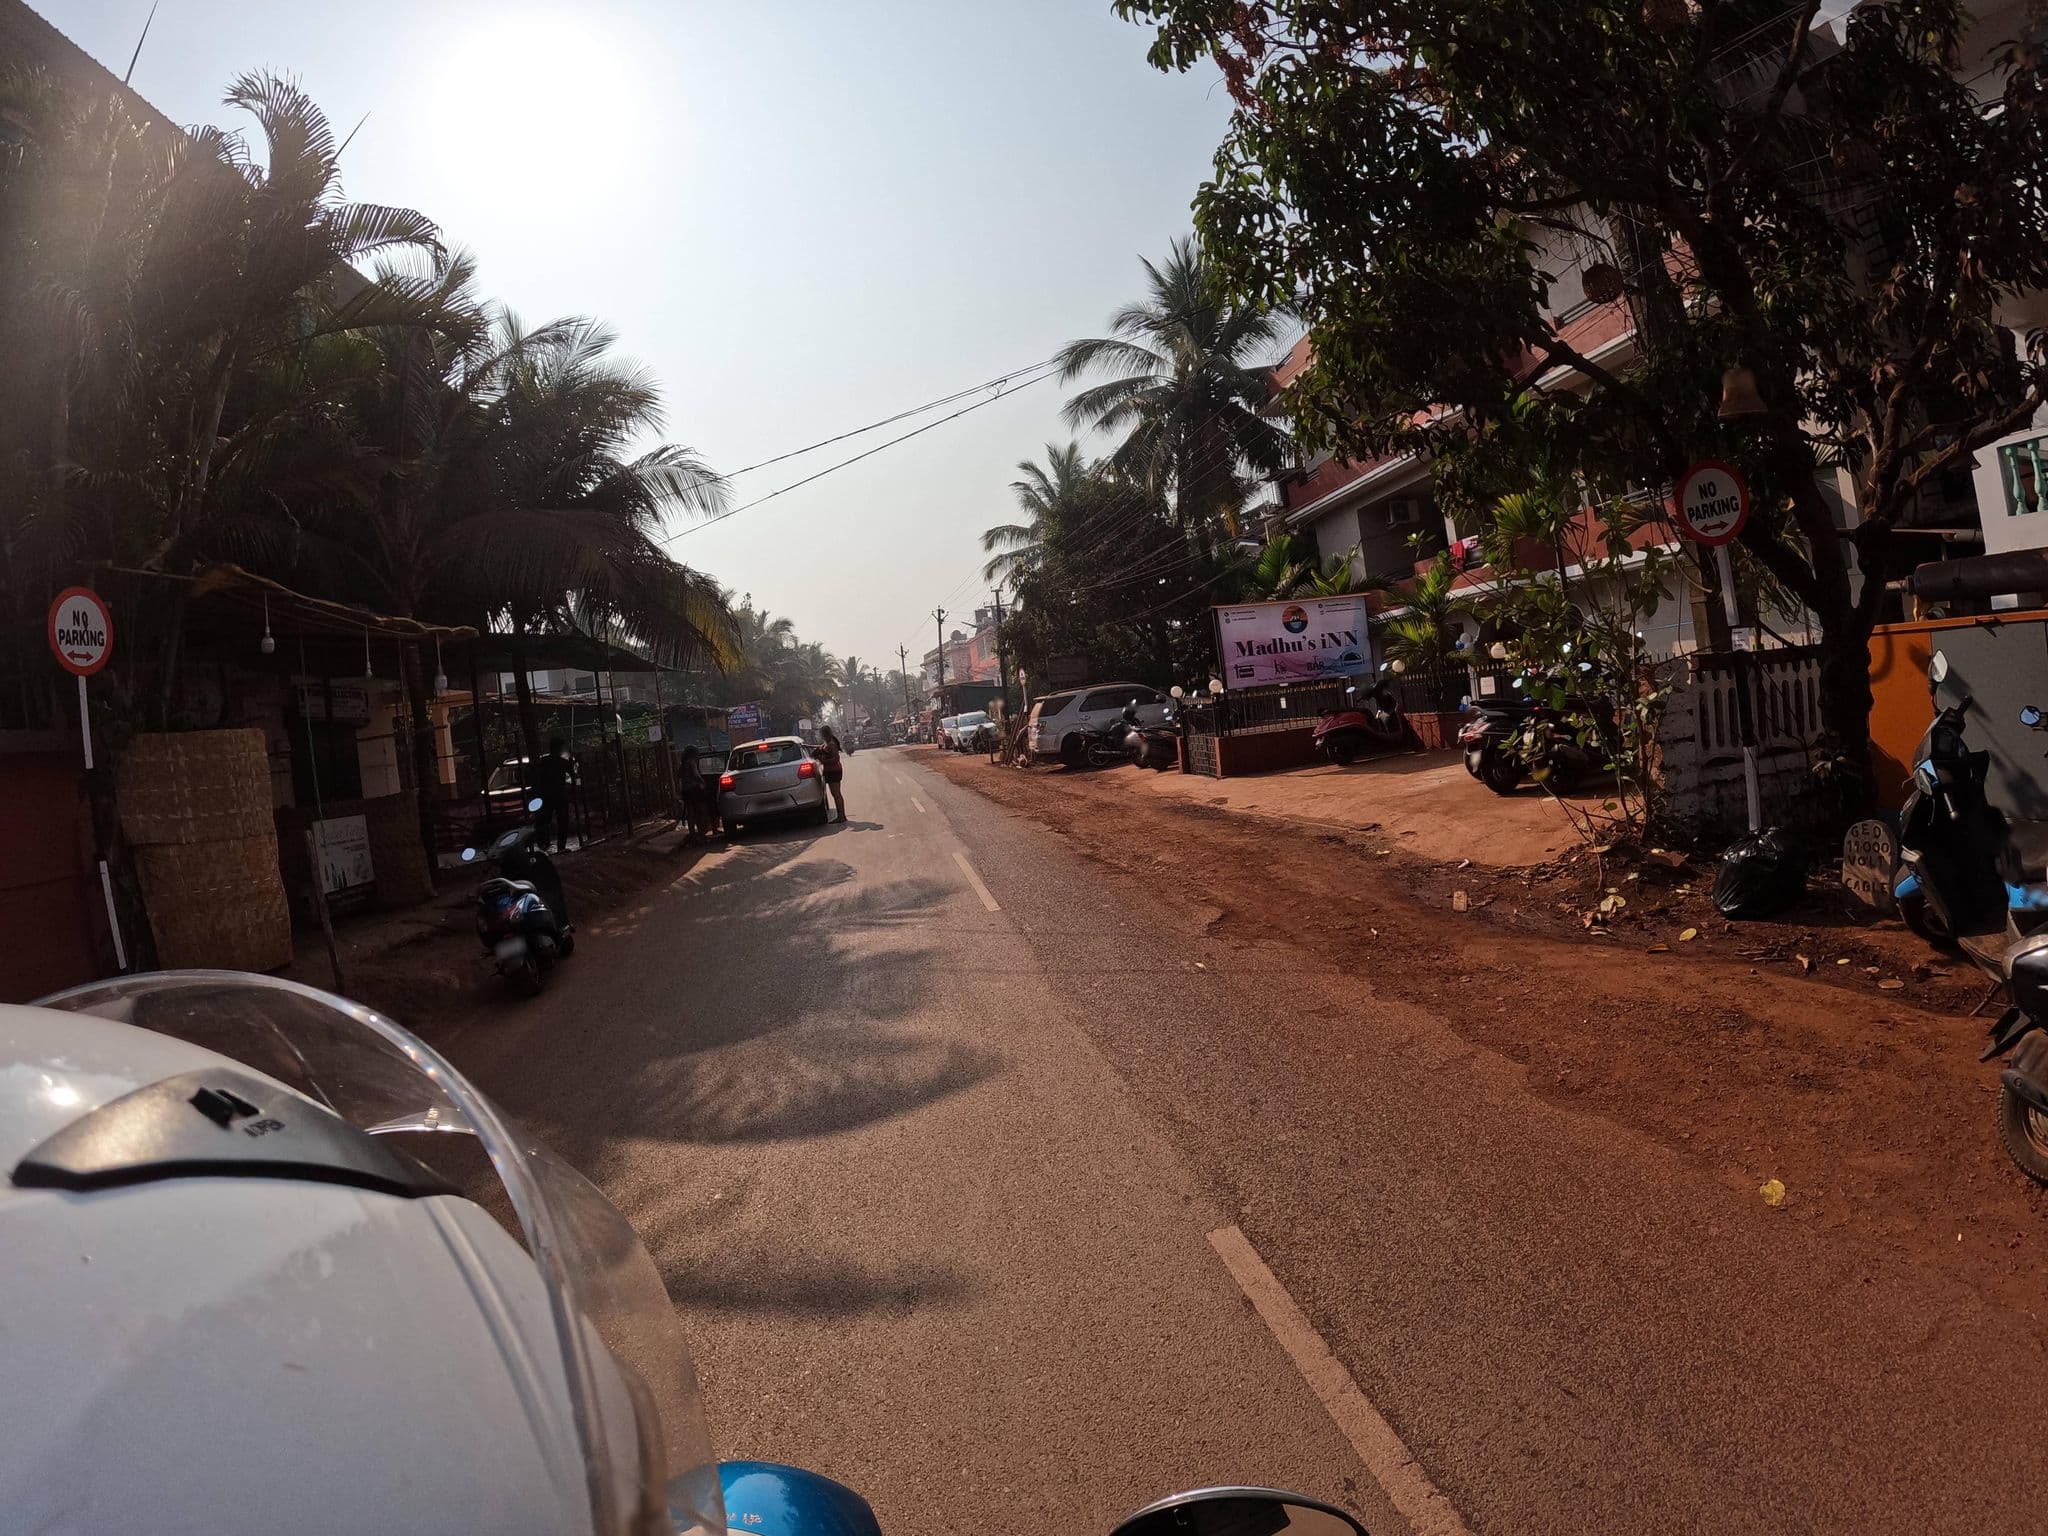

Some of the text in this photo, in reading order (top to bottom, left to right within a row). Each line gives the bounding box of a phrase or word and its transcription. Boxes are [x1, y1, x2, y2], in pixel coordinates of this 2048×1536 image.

[1698, 481, 1717, 499] NO
[1687, 496, 1740, 523] PARKING
[72, 609, 89, 628] NO
[58, 628, 105, 647] PARKING
[1234, 635, 1317, 658] Madhu's
[1847, 855, 1885, 868] VOLT
